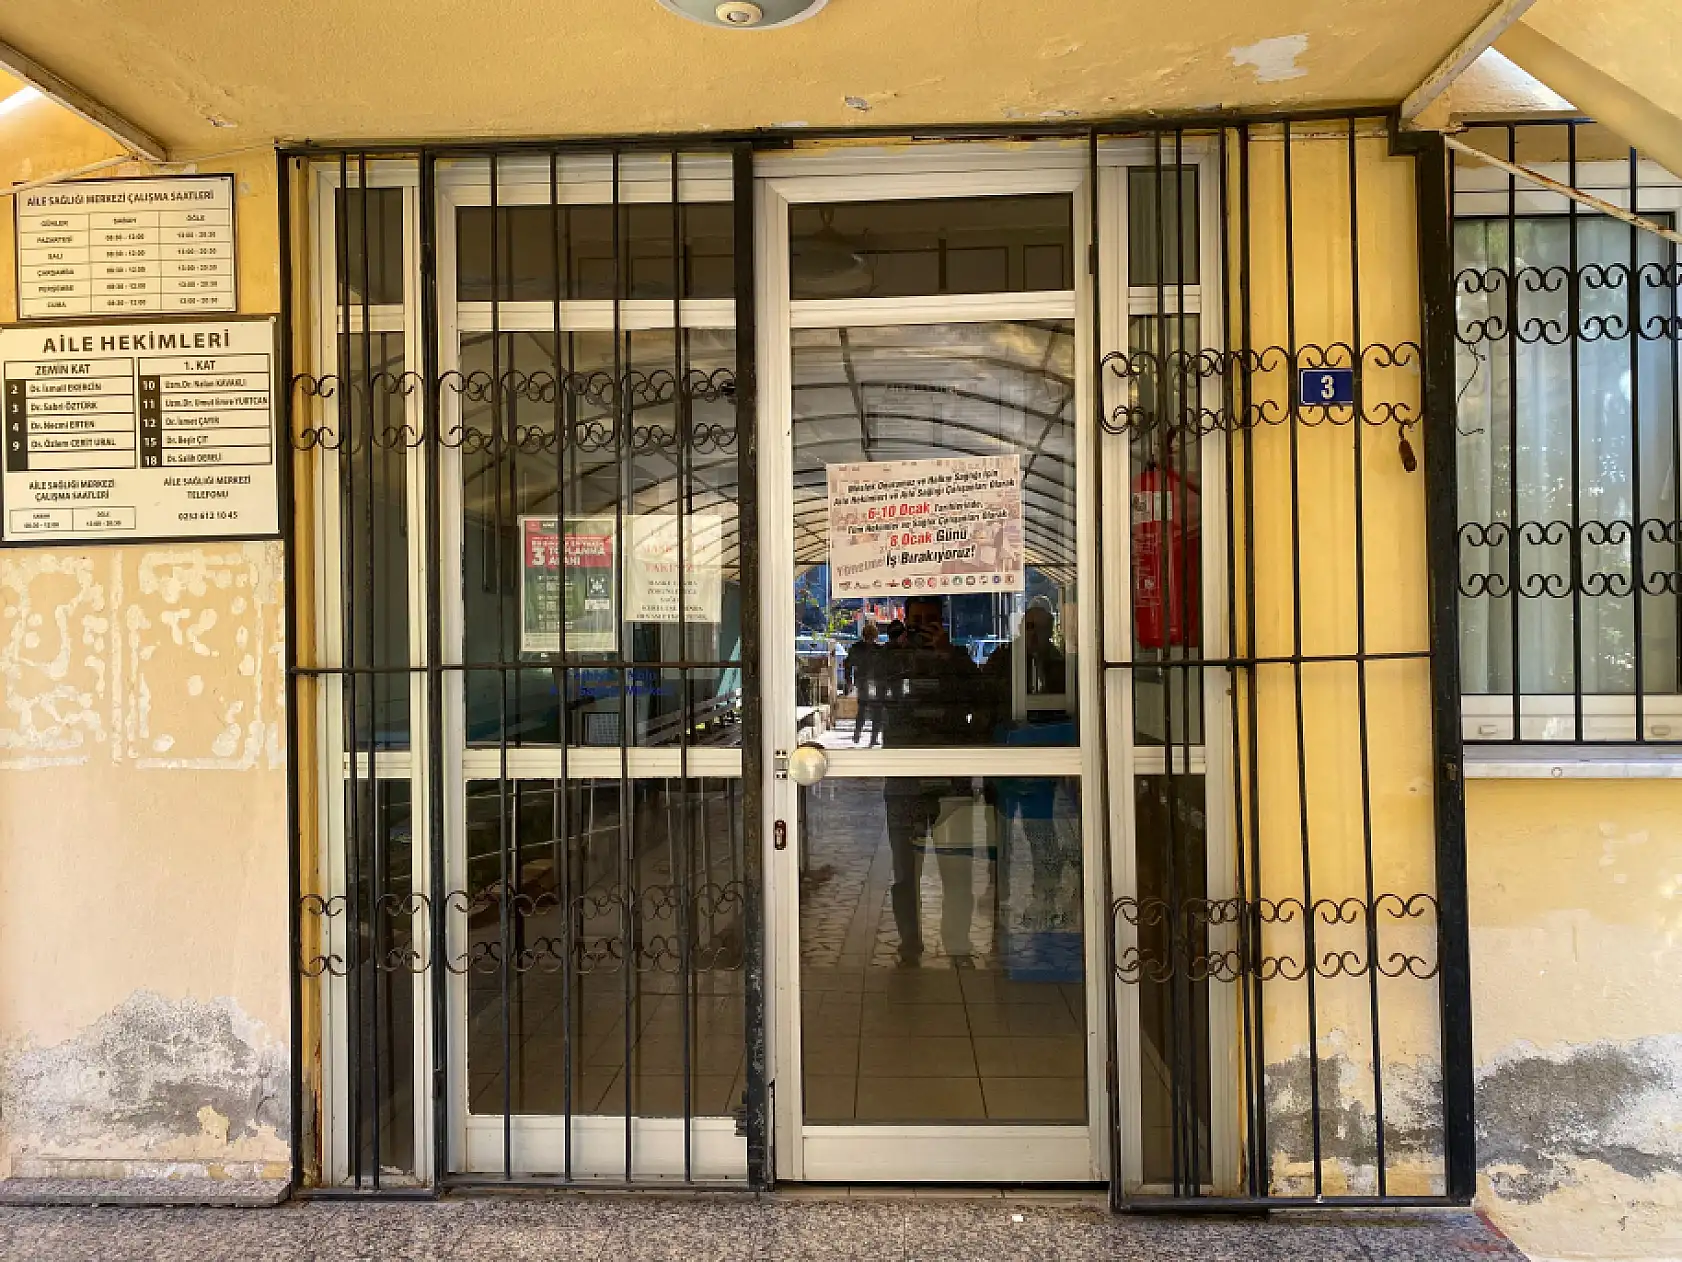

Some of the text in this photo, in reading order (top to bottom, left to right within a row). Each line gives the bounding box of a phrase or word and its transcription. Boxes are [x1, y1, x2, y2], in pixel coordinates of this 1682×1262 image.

[28, 195, 47, 206] AİLE
[86, 192, 126, 204] MERKEZİ
[128, 191, 168, 204] ÇALIŞMA
[43, 329, 229, 353] AİLE HEKİMLERİ
[35, 363, 91, 375] ZEMİN KAT
[184, 360, 216, 371] 1. KAT
[143, 380, 156, 390] 10
[1320, 375, 1335, 400] 3
[29, 480, 48, 490] AİLE
[80, 478, 115, 489] MERKEZİ
[164, 476, 182, 487] AİLE
[217, 474, 251, 485] MERKEZİ
[187, 490, 229, 500] TELEFONU
[868, 505, 897, 520] 6-10
[900, 502, 931, 516] Ocak
[901, 532, 932, 546] Ocak
[935, 529, 968, 543] Günü
[886, 543, 977, 569] İş Bırakıyoruz!
